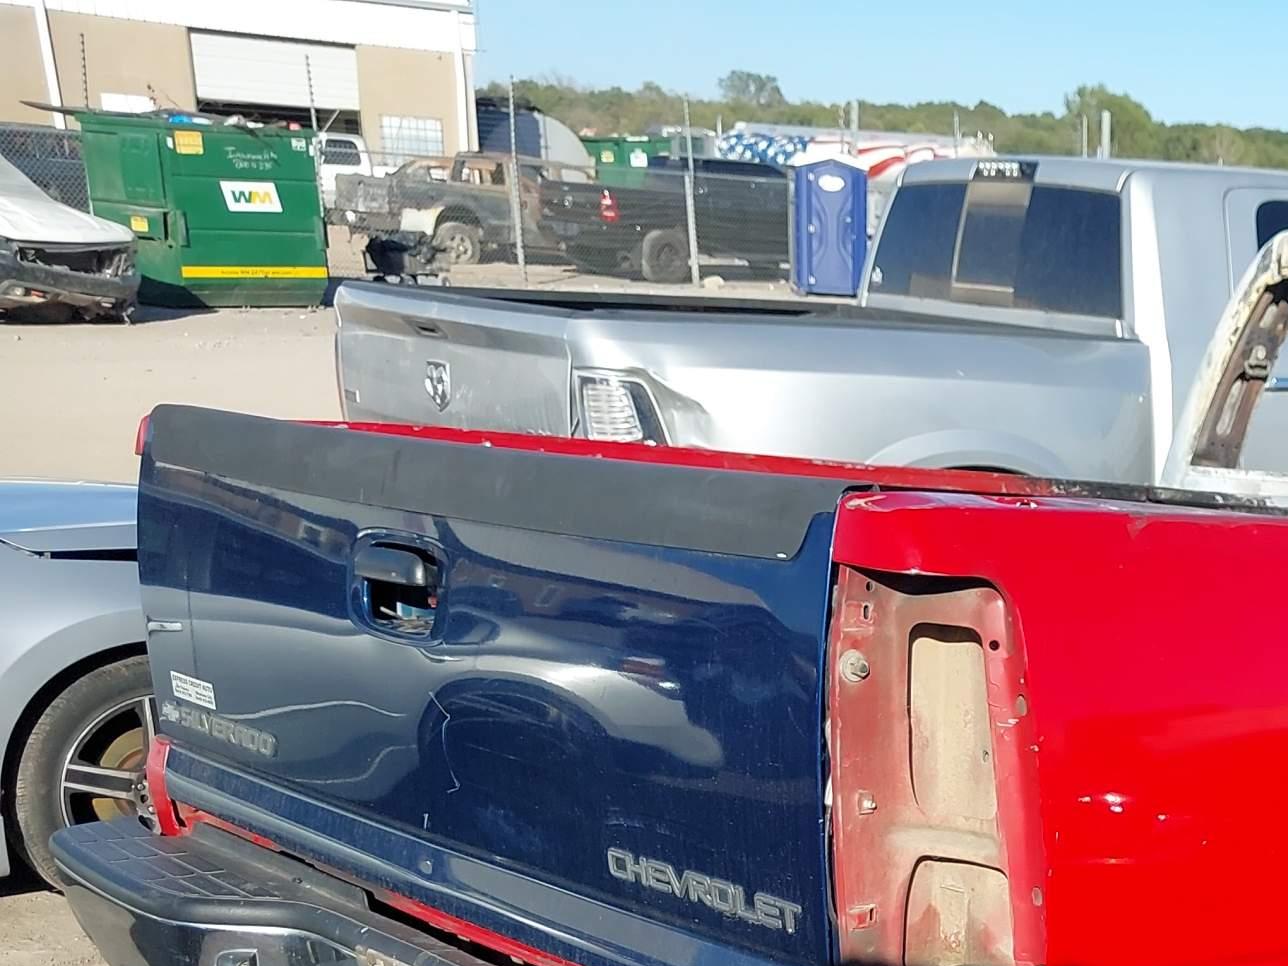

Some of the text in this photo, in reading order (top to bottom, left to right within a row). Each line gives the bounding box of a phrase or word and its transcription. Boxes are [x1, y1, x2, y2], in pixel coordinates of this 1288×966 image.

[231, 191, 273, 204] WM
[180, 706, 277, 757] SILVERADO
[607, 847, 802, 935] CHEVROLET
